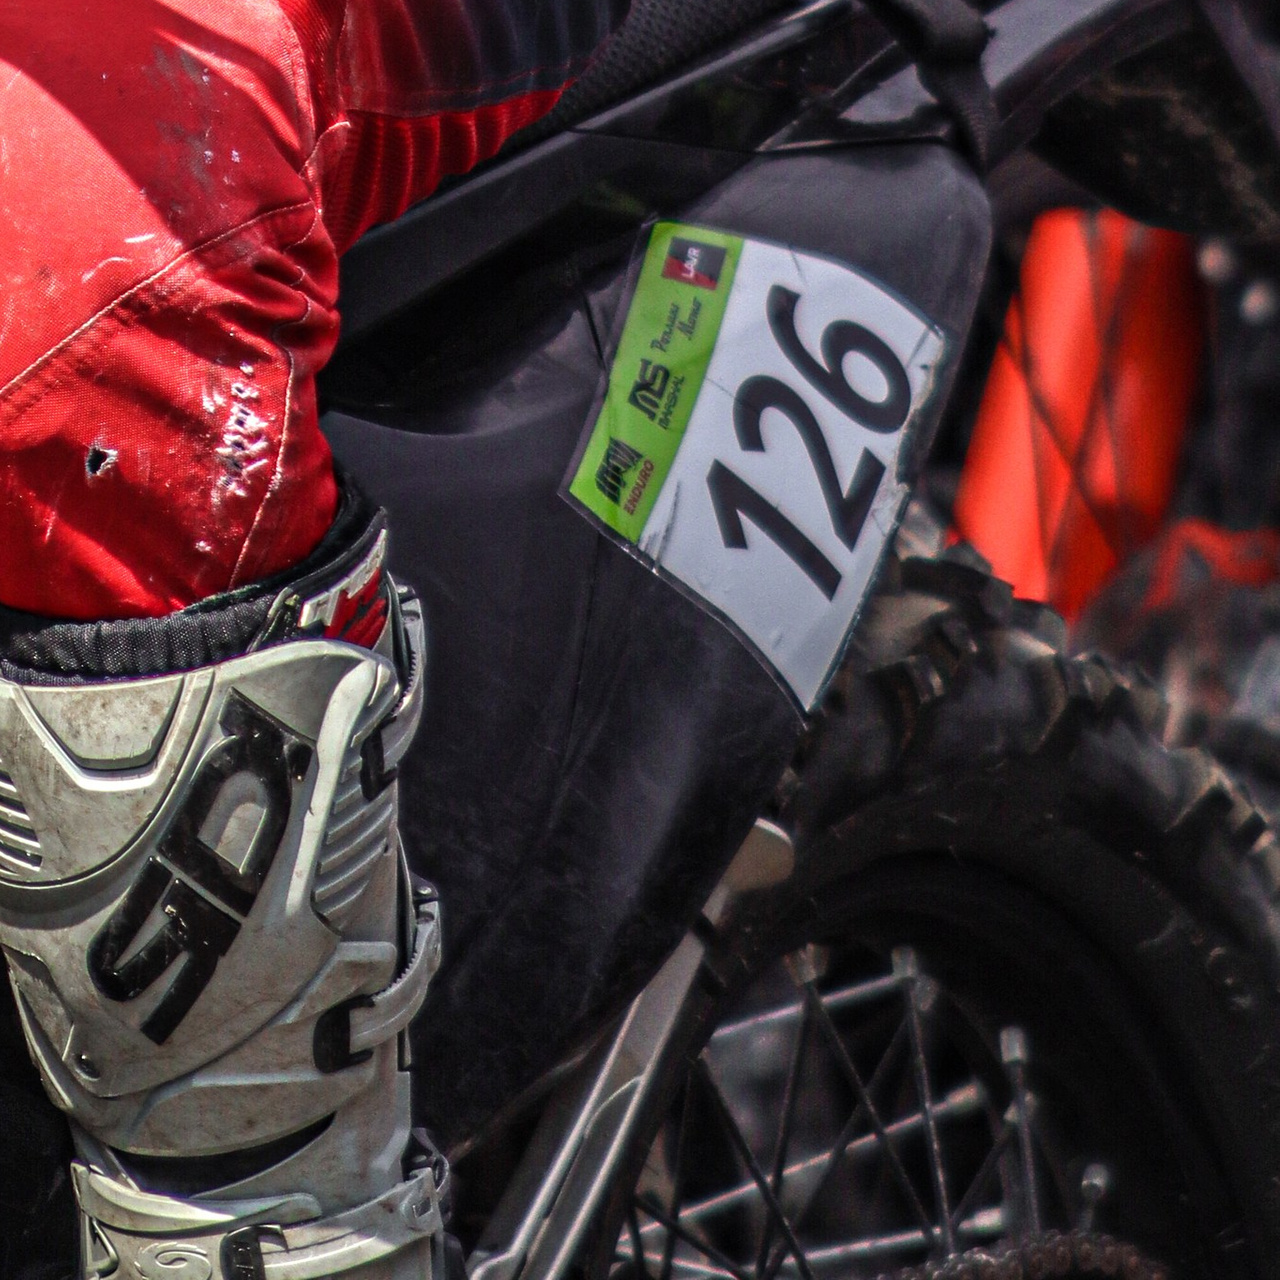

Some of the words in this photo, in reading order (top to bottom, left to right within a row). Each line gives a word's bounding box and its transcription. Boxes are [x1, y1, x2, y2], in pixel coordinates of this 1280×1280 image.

[681, 246, 700, 280] LAVR
[706, 283, 912, 603] 126
[624, 459, 656, 516] ENDURO
